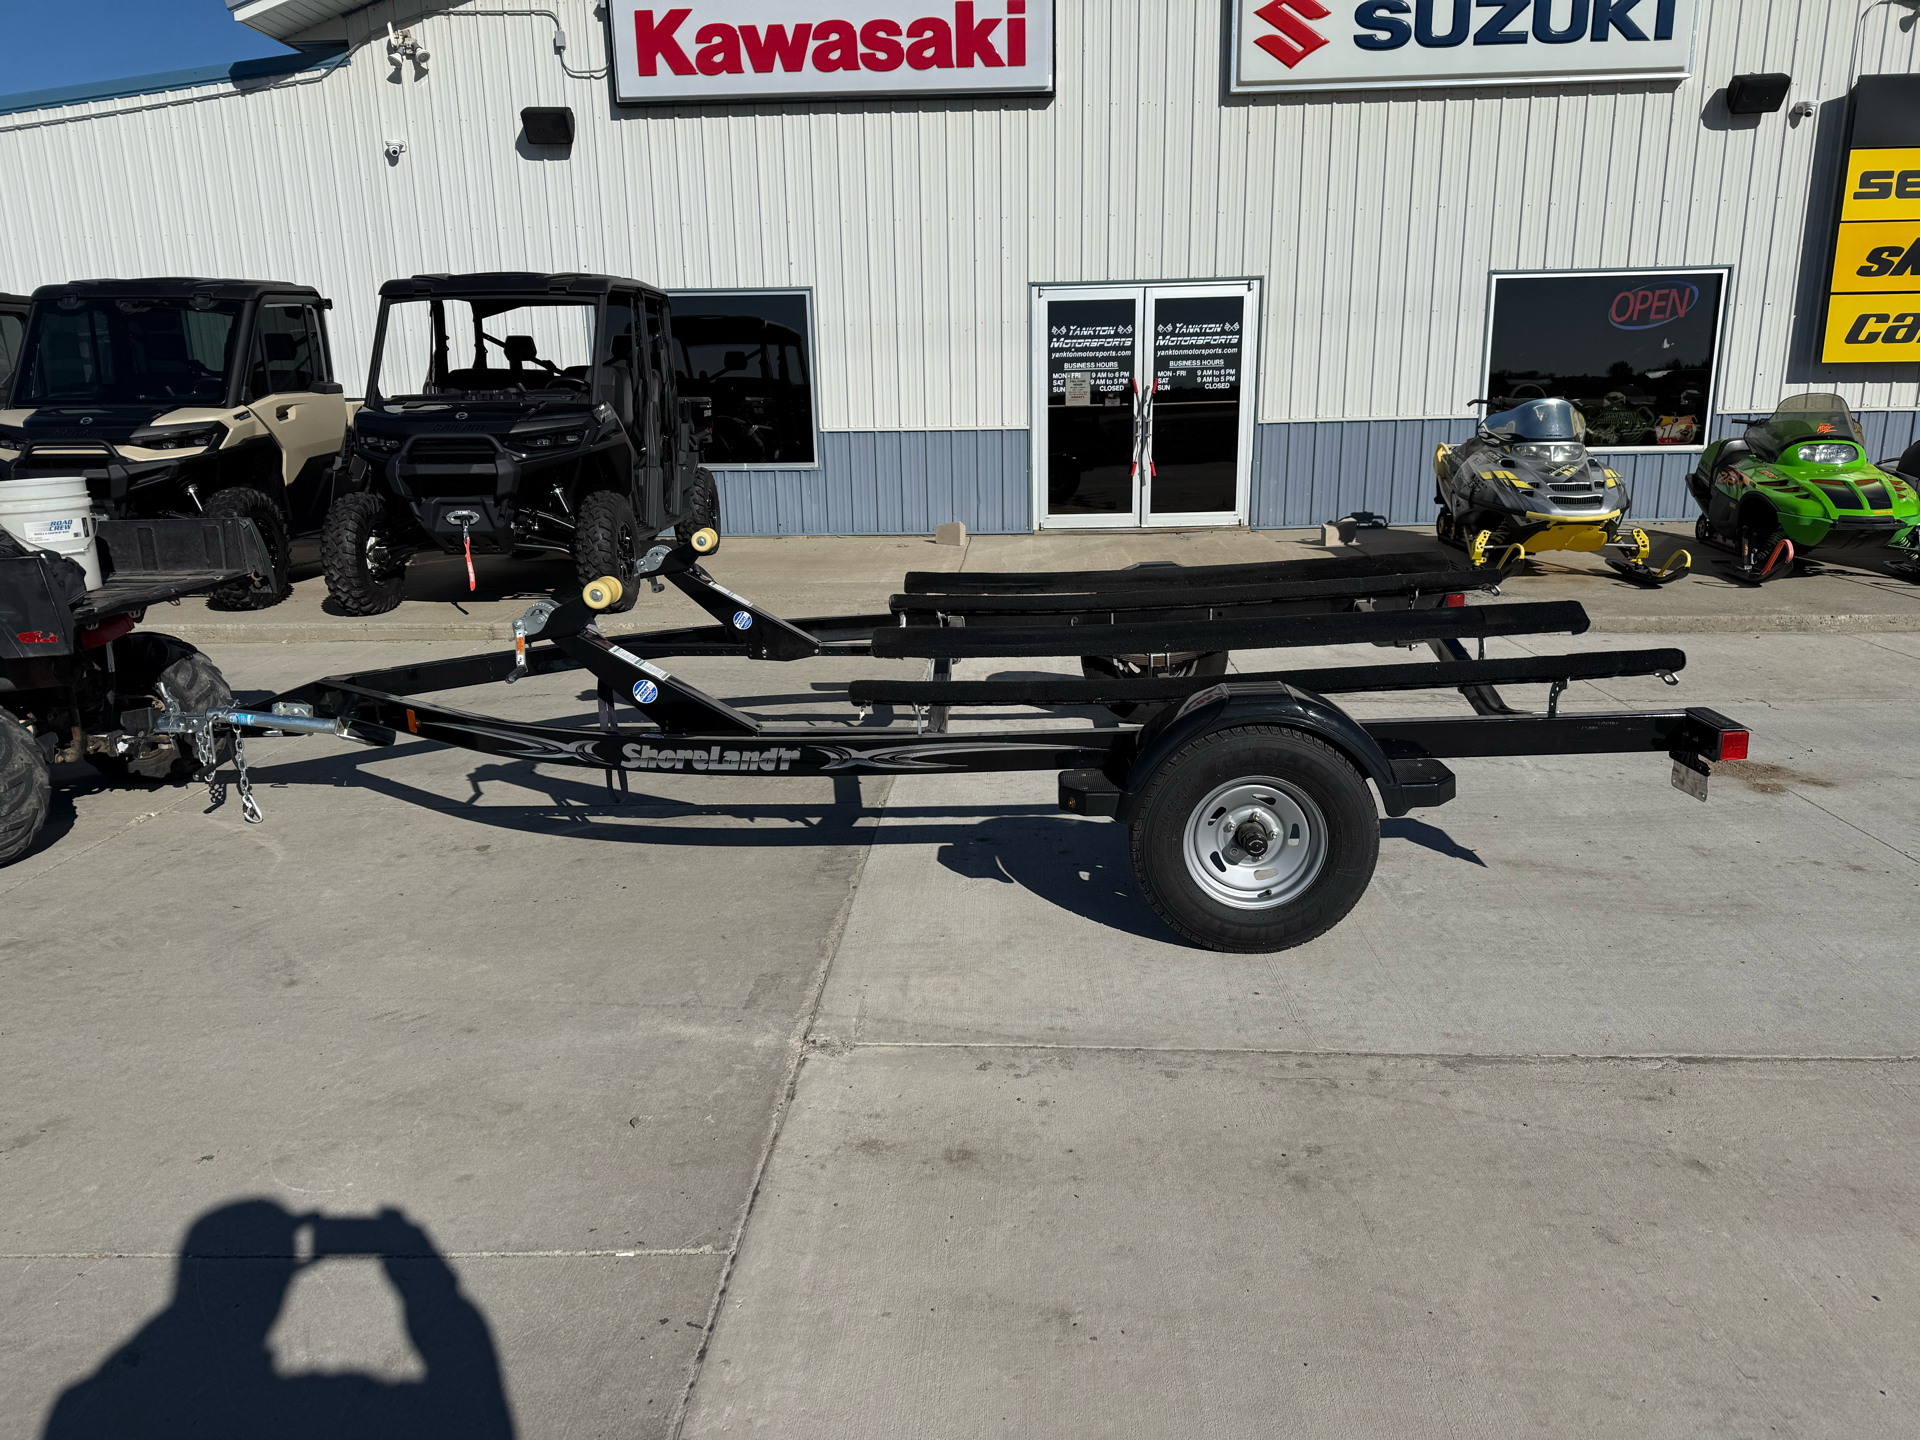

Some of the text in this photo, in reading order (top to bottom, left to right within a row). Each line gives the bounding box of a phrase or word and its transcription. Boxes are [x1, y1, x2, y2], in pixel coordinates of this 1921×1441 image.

[1353, 0, 1675, 51] SUZUKI
[634, 0, 1026, 76] Kawasaki
[1610, 288, 1690, 323] OPEN
[1069, 326, 1116, 336] YANKTON
[1175, 323, 1222, 334] YANKTON
[1844, 312, 1920, 344] ca
[1050, 338, 1132, 348] MOTORSPORTS
[1156, 335, 1240, 346] MOTORSPORTS
[1051, 350, 1131, 359] yanktonmotorsports.com
[1157, 348, 1238, 357] yanktonmotorsports.com
